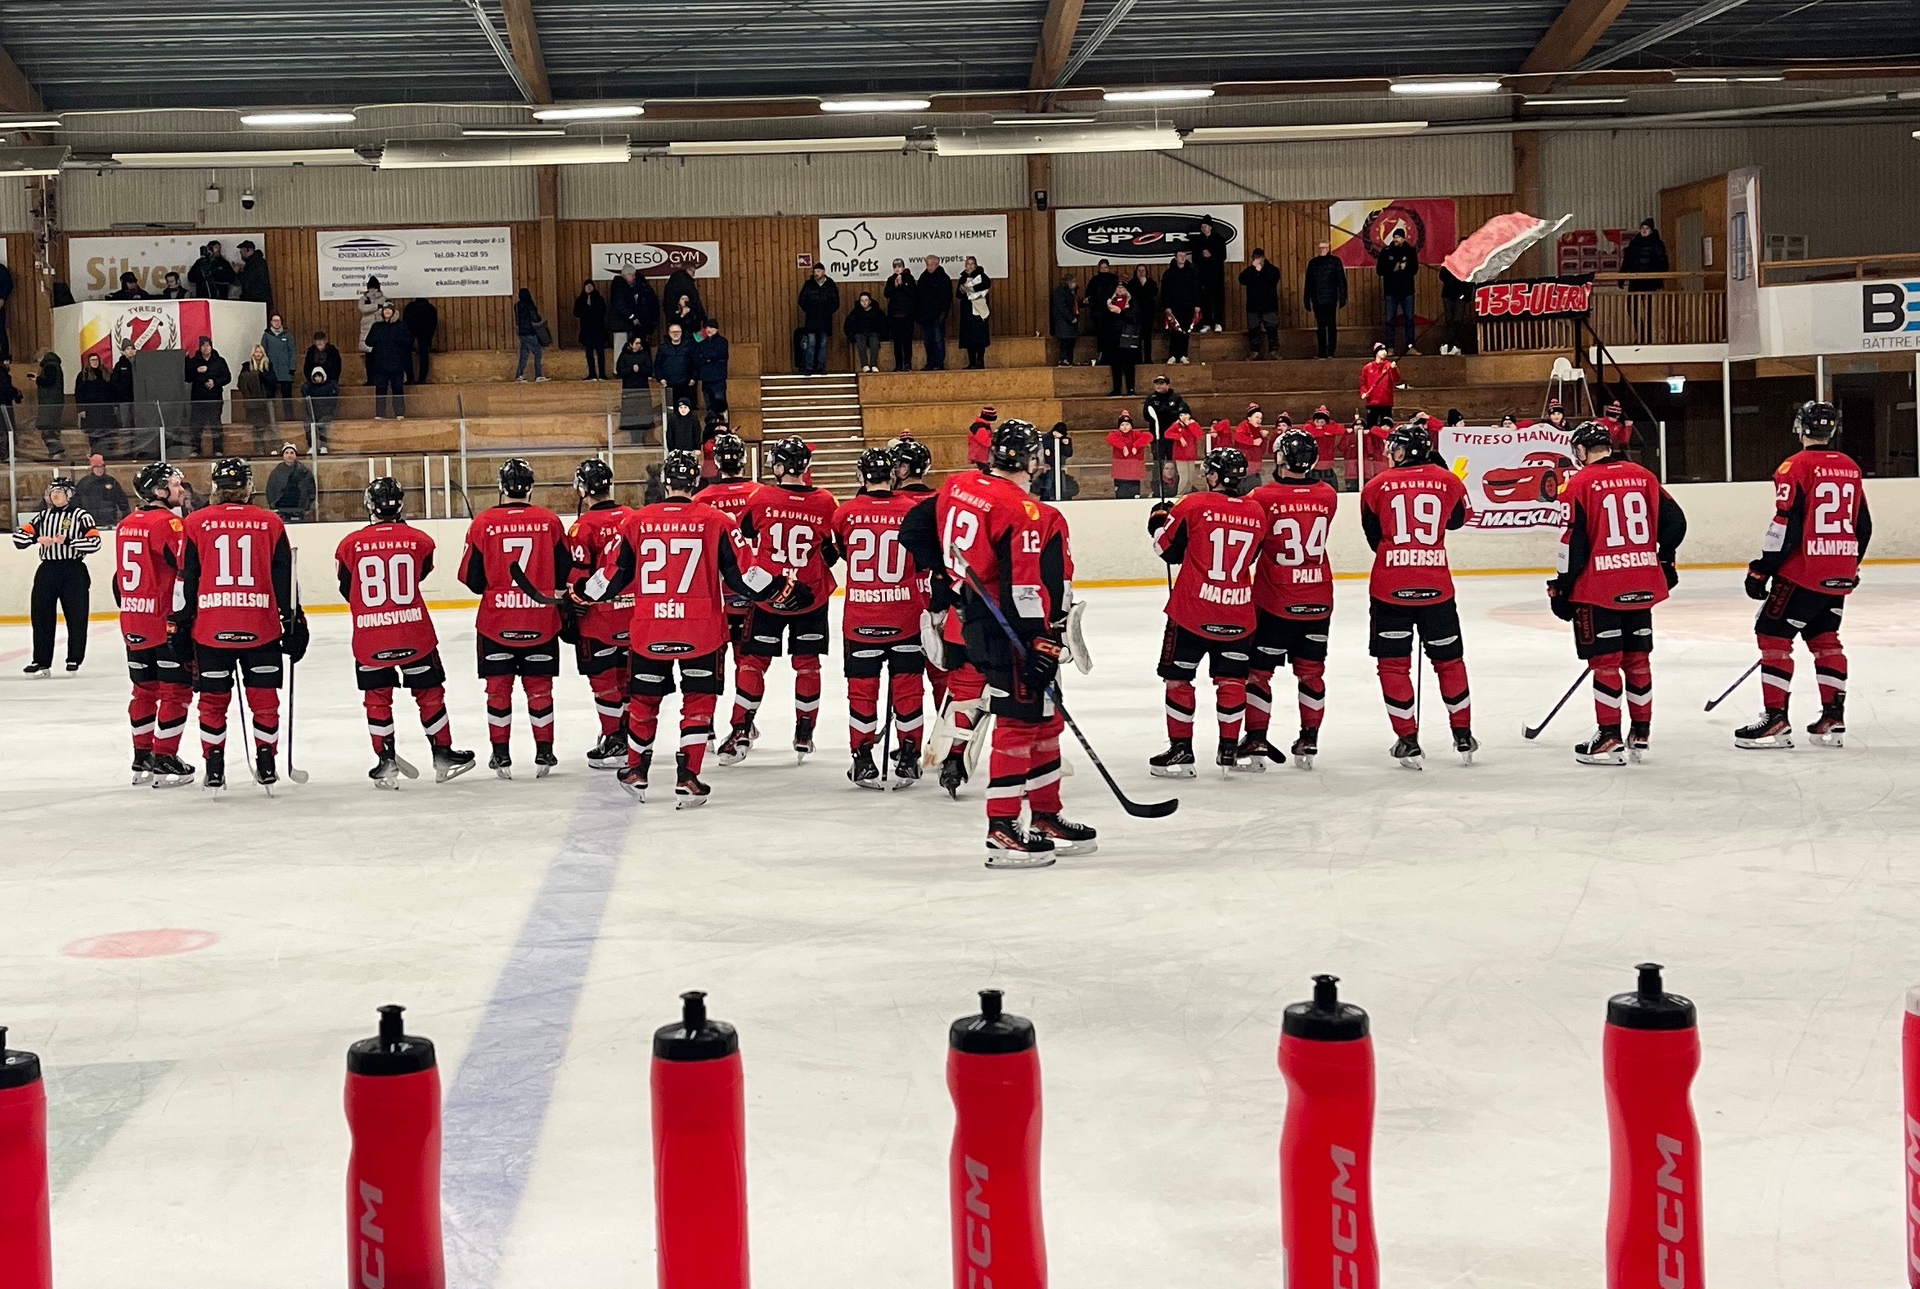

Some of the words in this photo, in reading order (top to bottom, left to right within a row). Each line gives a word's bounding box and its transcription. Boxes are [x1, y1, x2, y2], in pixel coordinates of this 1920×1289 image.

[885, 230, 953, 241] DJURSJUKVÅRD
[954, 231, 958, 239] I
[959, 229, 997, 239] HEMMET
[1088, 225, 1142, 234] LÄNNA
[605, 249, 663, 264] TYRESÖ
[669, 250, 700, 263] GYM
[830, 258, 879, 277] myPets
[1862, 335, 1912, 349] BÄTTRE
[1820, 467, 1859, 479] BAUHAUS
[1391, 480, 1448, 492] BAUHAUS
[1601, 478, 1647, 489] BAUHAUS
[773, 509, 824, 525] BAUHAUS
[1280, 502, 1329, 515] BAUHAUS
[1814, 482, 1855, 534] 23
[211, 521, 268, 530] BAUHAUS
[495, 523, 549, 534] BAUHAUS
[646, 523, 705, 534] BAUHAUS
[855, 514, 904, 525] BAUHAU
[1213, 512, 1261, 528] BAUHAUS
[1390, 493, 1443, 546] 19
[1602, 491, 1650, 548] 18
[363, 541, 417, 551] BAUHAUS
[769, 522, 814, 568] 16
[943, 505, 979, 579] 12
[1021, 530, 1041, 553] 12
[1273, 516, 1328, 567] 34
[214, 534, 255, 587] 11
[502, 537, 533, 587] 7
[849, 528, 907, 584] 20
[1207, 527, 1254, 583] 17
[1386, 550, 1446, 567] PEDERSEN
[122, 541, 143, 592] 5
[640, 538, 703, 594] 27
[358, 553, 415, 607] 80
[1292, 568, 1323, 583] PALM
[199, 591, 270, 609] GABRIELSON
[849, 585, 911, 603] BERGSTRÖM
[654, 598, 685, 619] ISÉN
[357, 607, 422, 629] OUNASVUORI
[1656, 1132, 1684, 1289] CCM
